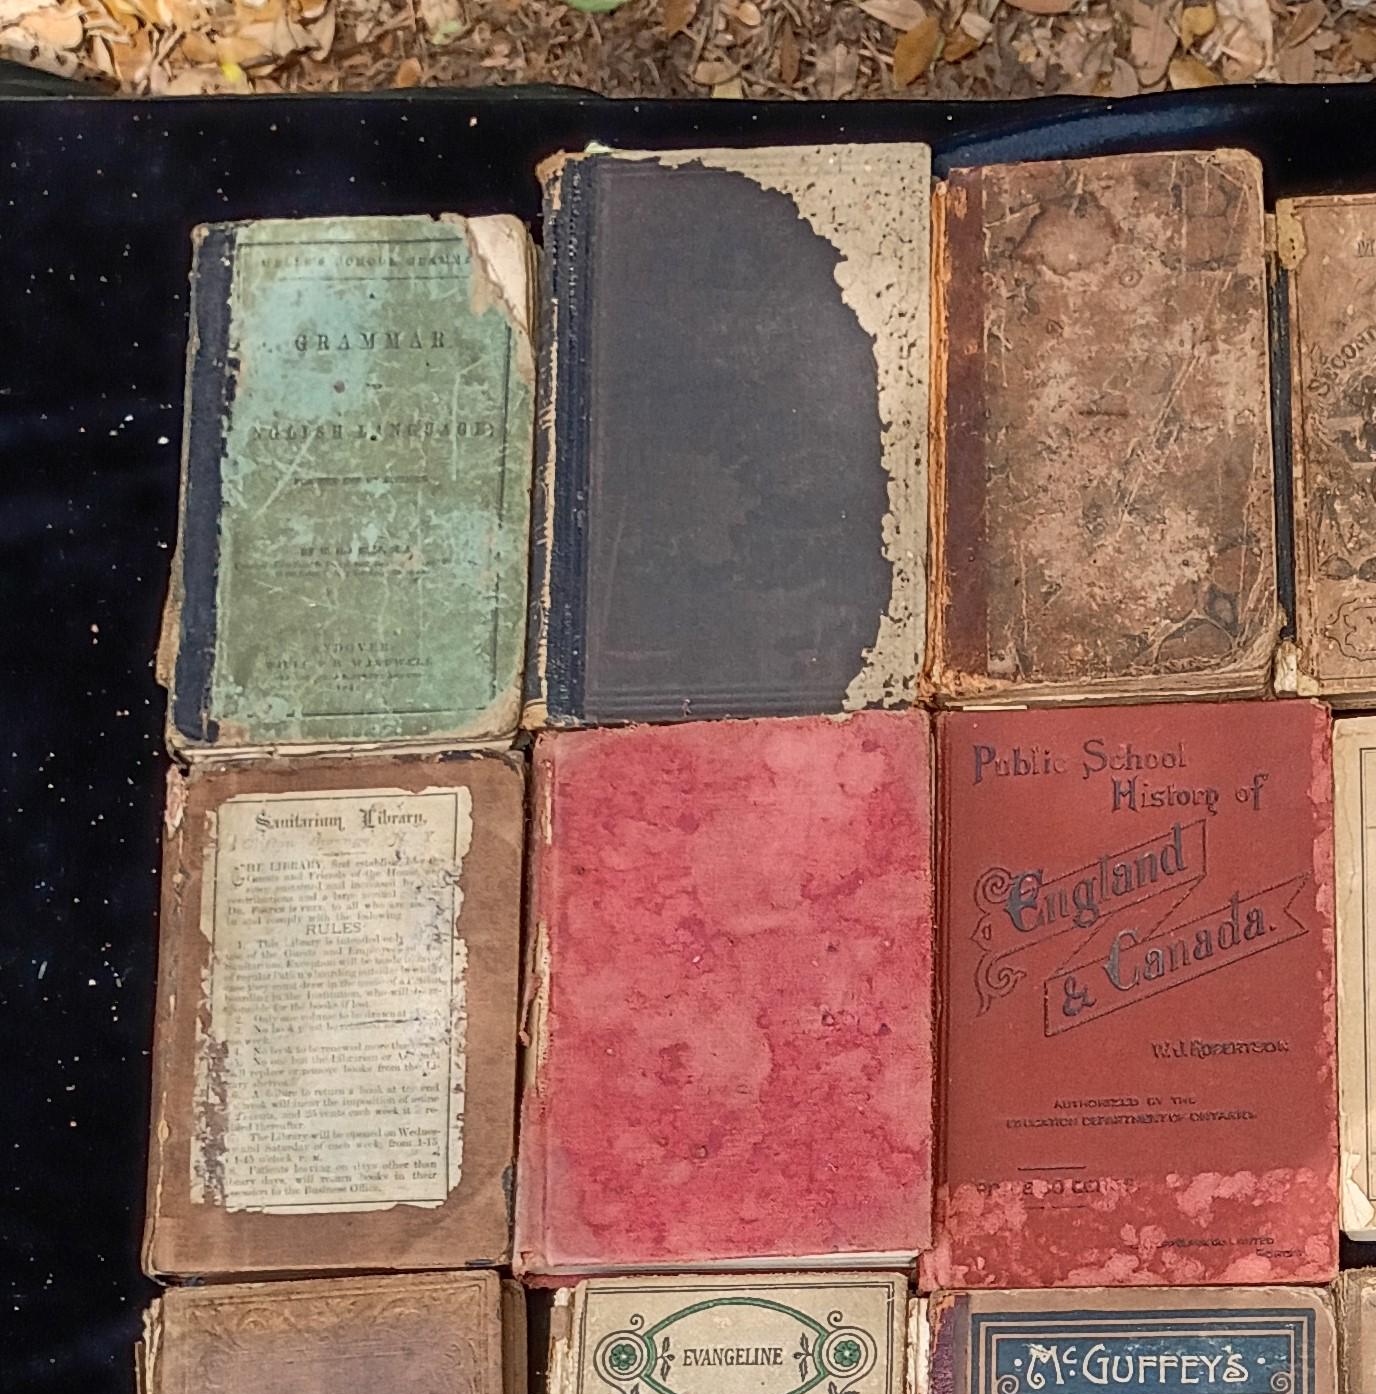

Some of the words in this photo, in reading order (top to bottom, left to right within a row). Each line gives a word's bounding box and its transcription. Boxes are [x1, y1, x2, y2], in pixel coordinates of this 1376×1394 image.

[294, 331, 446, 352] GRAMMAR
[973, 744, 1067, 785] Public
[1082, 739, 1187, 779] School
[1111, 775, 1219, 816] History
[1235, 772, 1269, 811] of
[1004, 821, 1188, 933] England
[306, 922, 363, 936] RULES
[1062, 976, 1097, 1017] &
[682, 1347, 783, 1367] EVANGELINE
